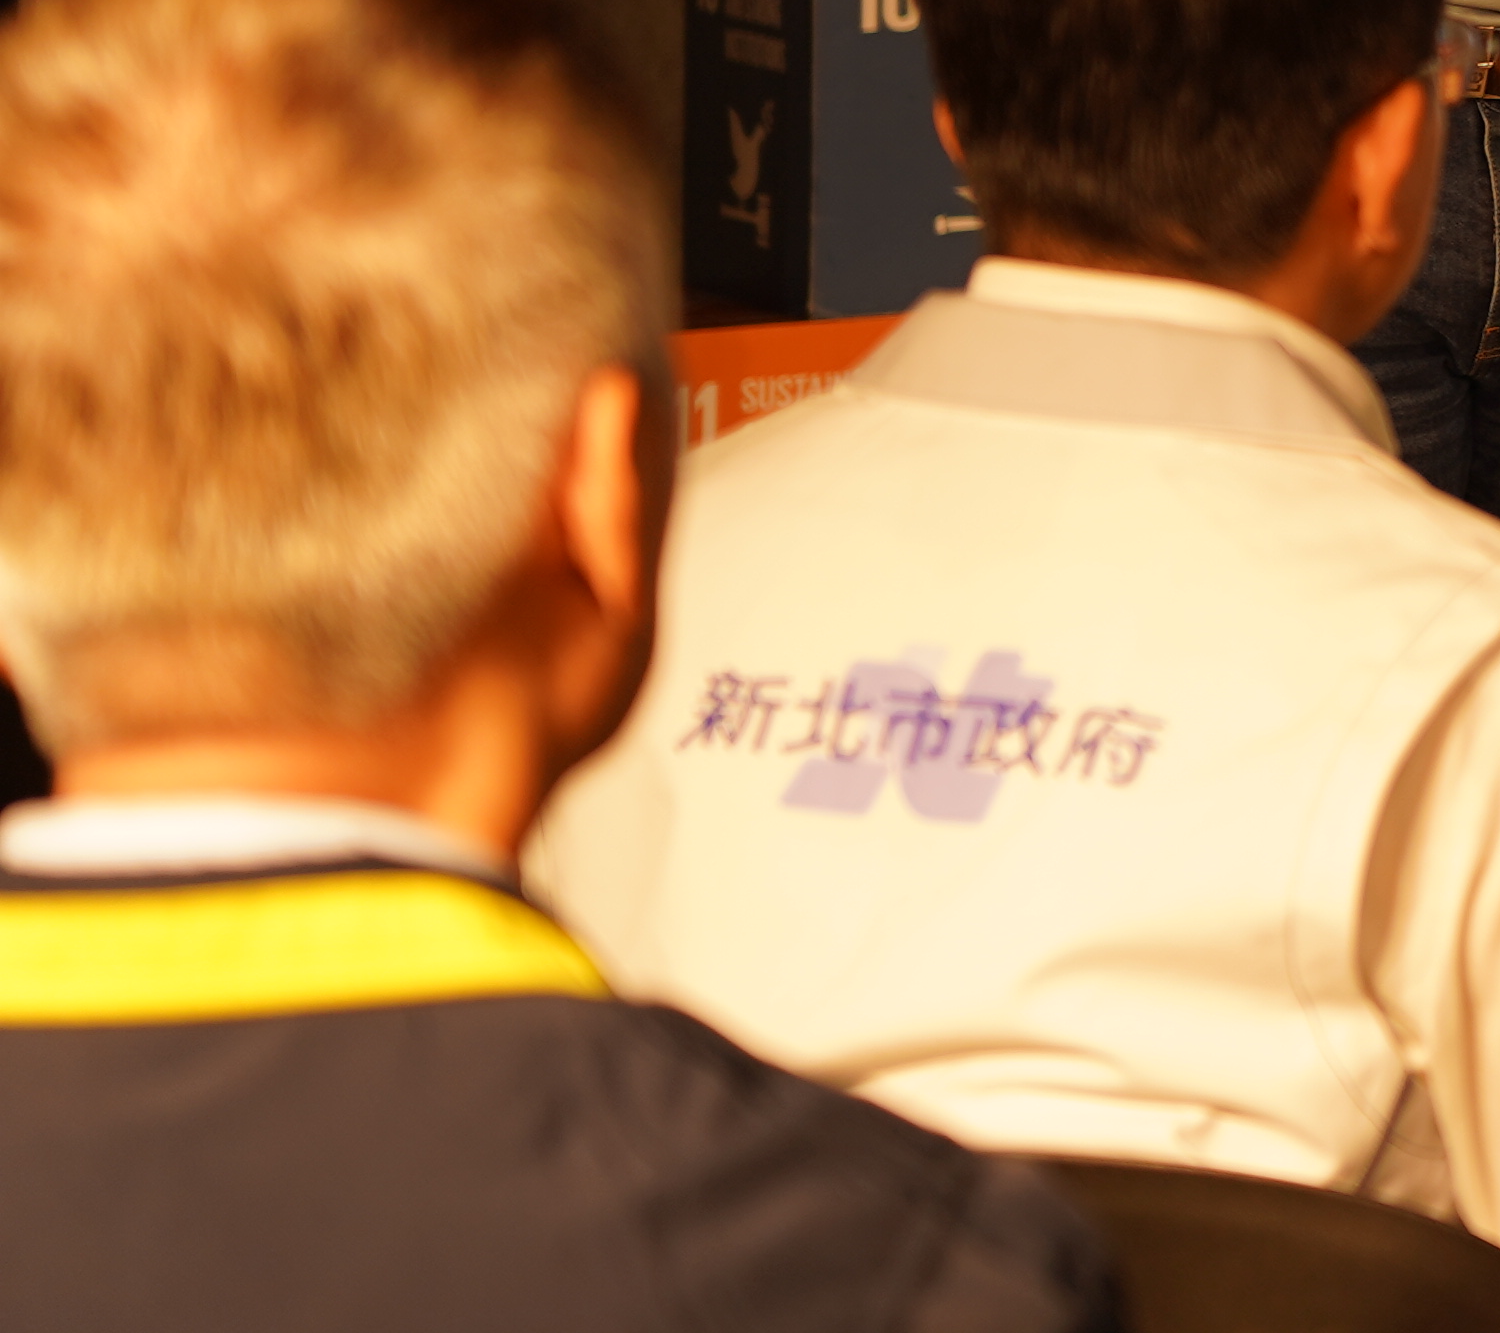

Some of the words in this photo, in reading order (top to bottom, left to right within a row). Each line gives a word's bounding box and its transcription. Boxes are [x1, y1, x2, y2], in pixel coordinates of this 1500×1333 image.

[674, 671, 1166, 786] 新北市政府
